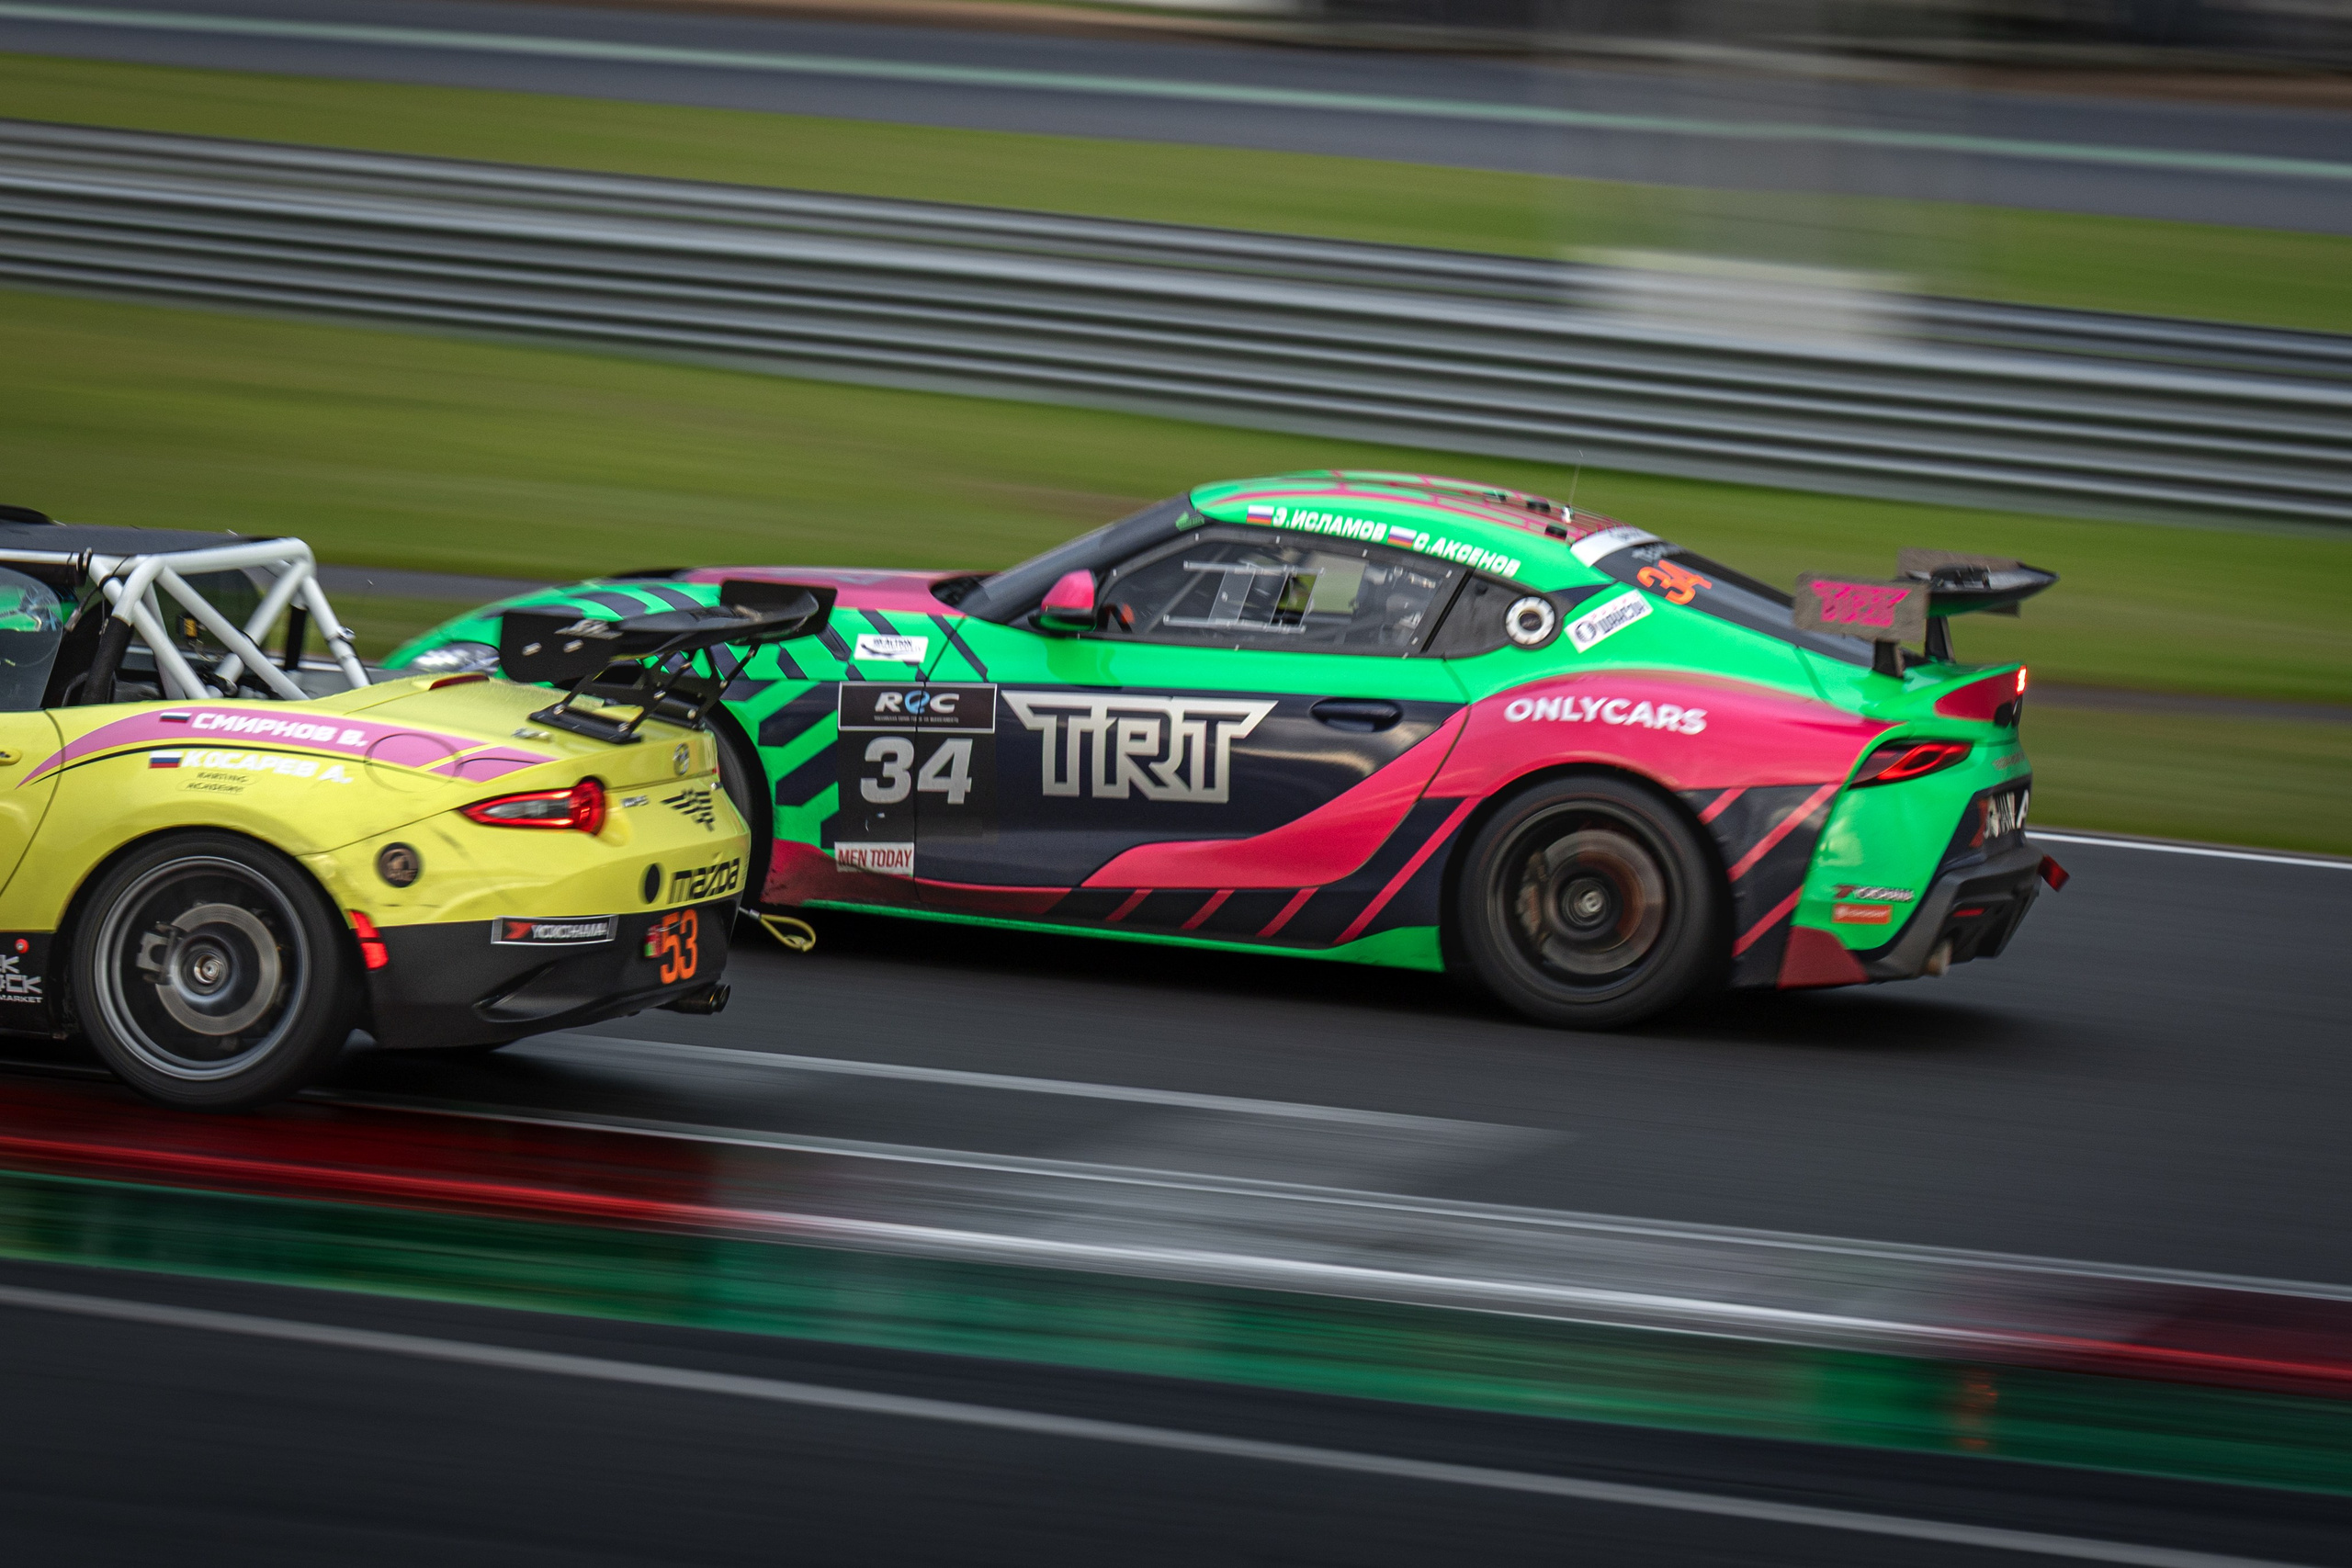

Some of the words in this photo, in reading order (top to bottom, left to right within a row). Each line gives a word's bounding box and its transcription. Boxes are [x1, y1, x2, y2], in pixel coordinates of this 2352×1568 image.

[1272, 506, 1387, 543] Э.ИСЛАМОВ
[1413, 532, 1521, 579] С.АКСЕНОВ
[191, 713, 338, 742] СМИРНОВ
[336, 728, 369, 747] В.
[1504, 695, 1707, 735] ONLYCARS
[180, 750, 320, 778] КОСАРЕВ
[317, 763, 354, 784] А.
[860, 737, 973, 805] 34
[838, 849, 866, 867] MEN
[871, 849, 912, 868] TODAY
[660, 908, 698, 985] 53
